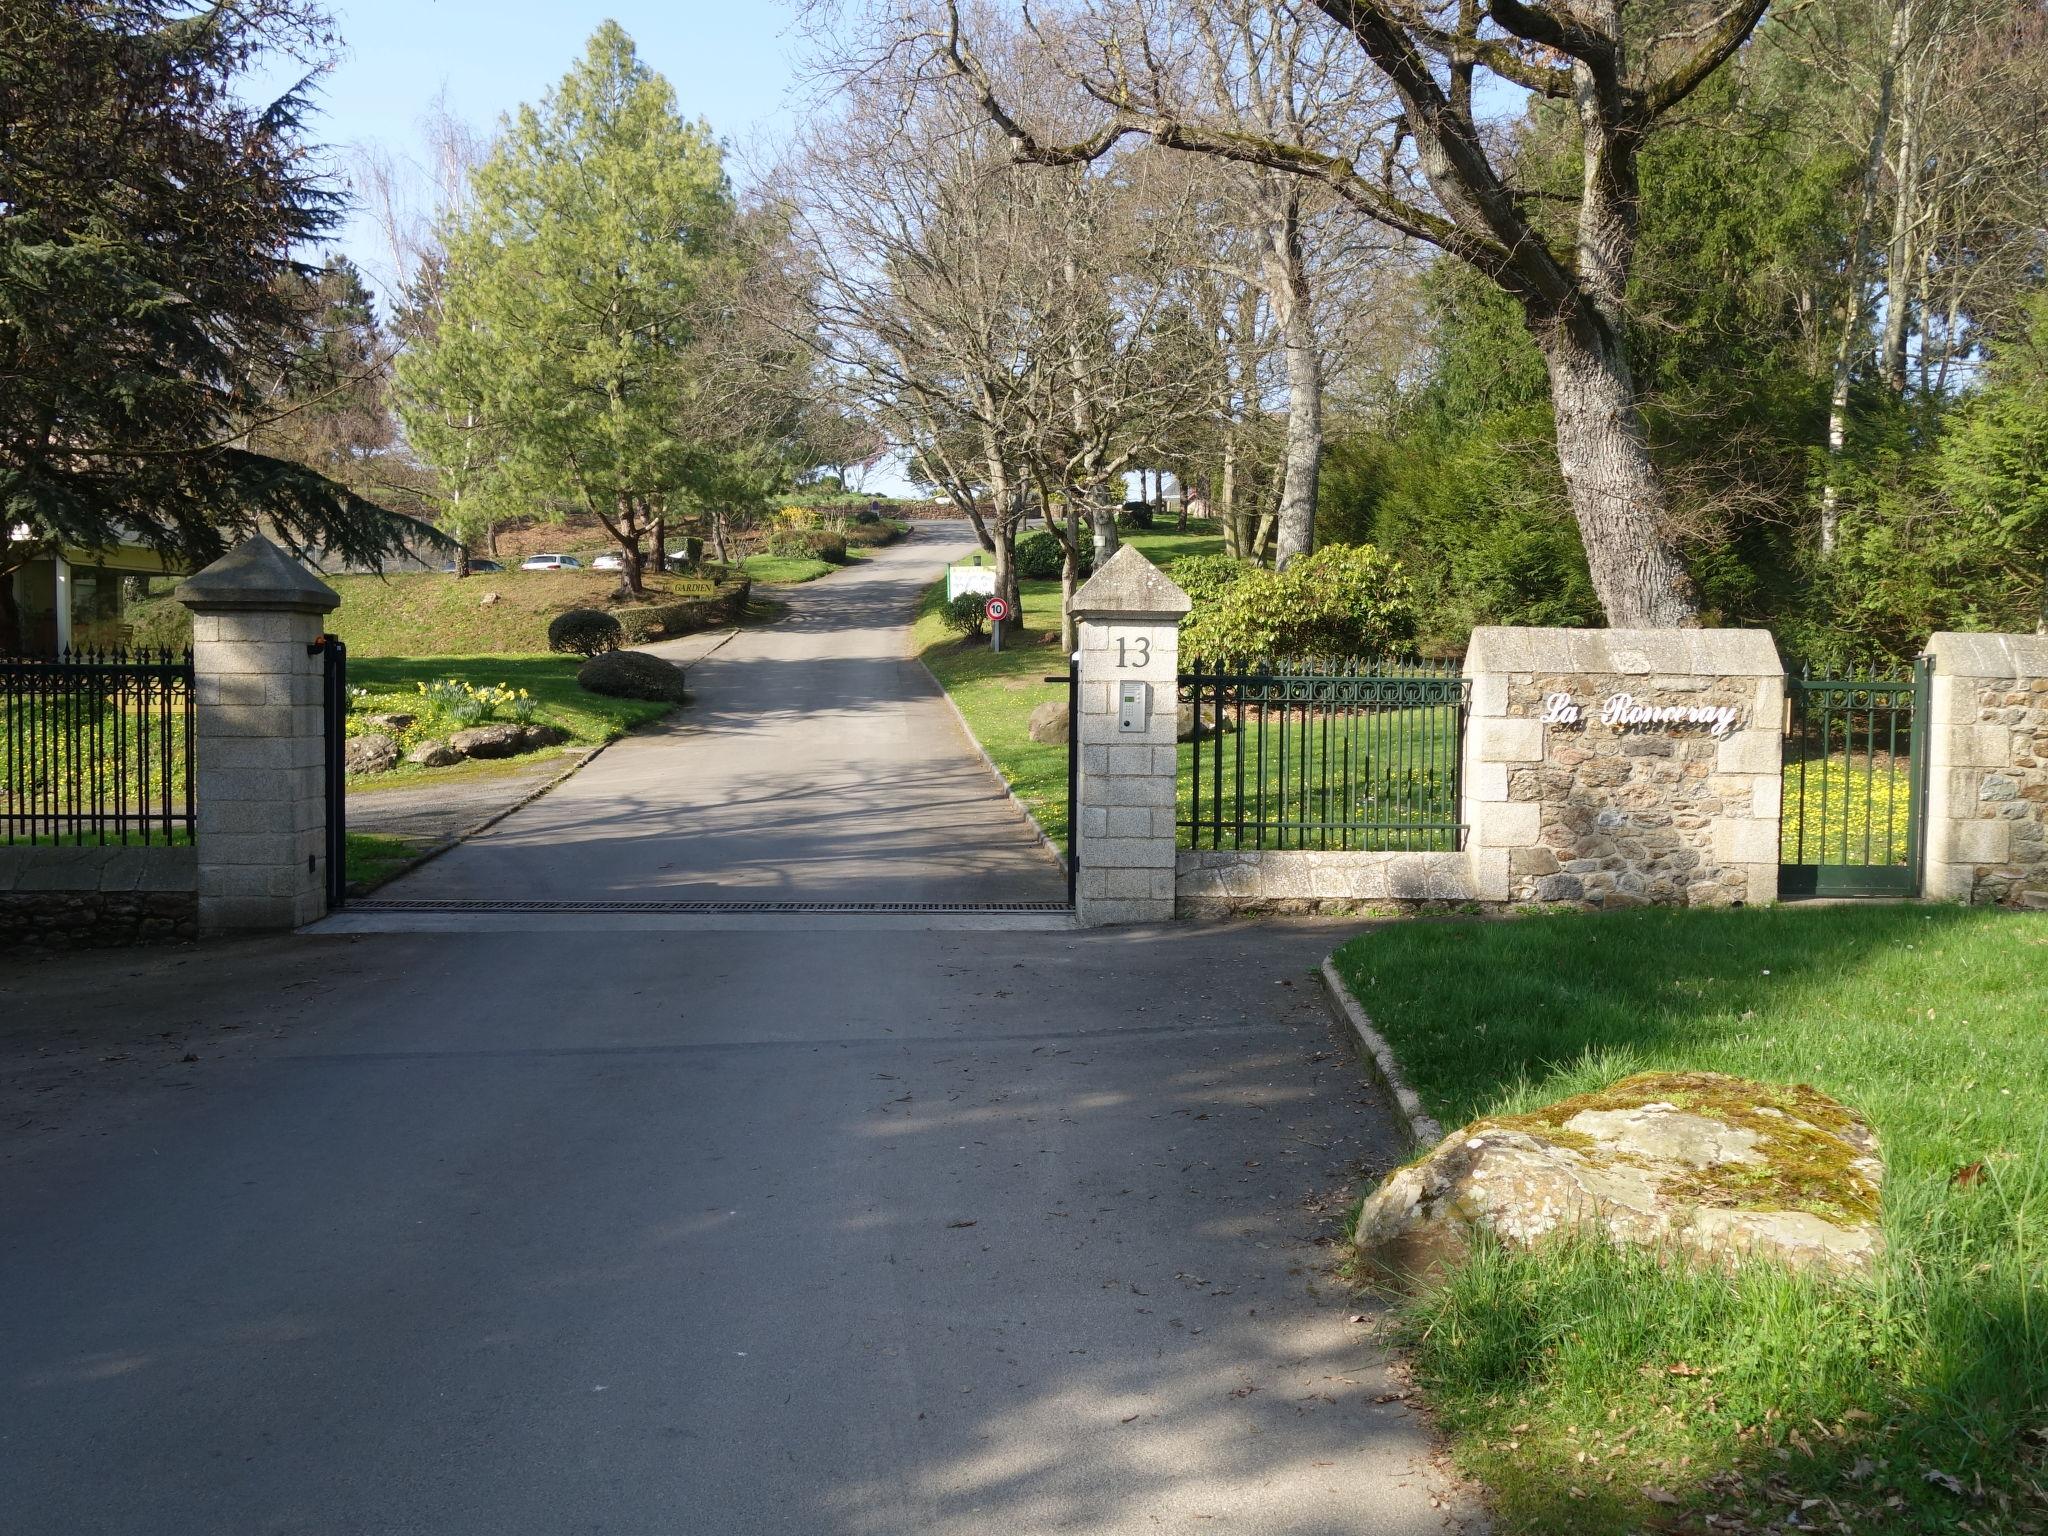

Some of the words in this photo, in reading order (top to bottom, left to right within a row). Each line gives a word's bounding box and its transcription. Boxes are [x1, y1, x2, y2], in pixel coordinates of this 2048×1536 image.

[674, 583, 712, 592] GARDIEN
[991, 604, 1003, 614] 10
[1115, 636, 1151, 668] 13
[1540, 692, 1578, 724] La
[1600, 692, 1736, 735] Ronceray
